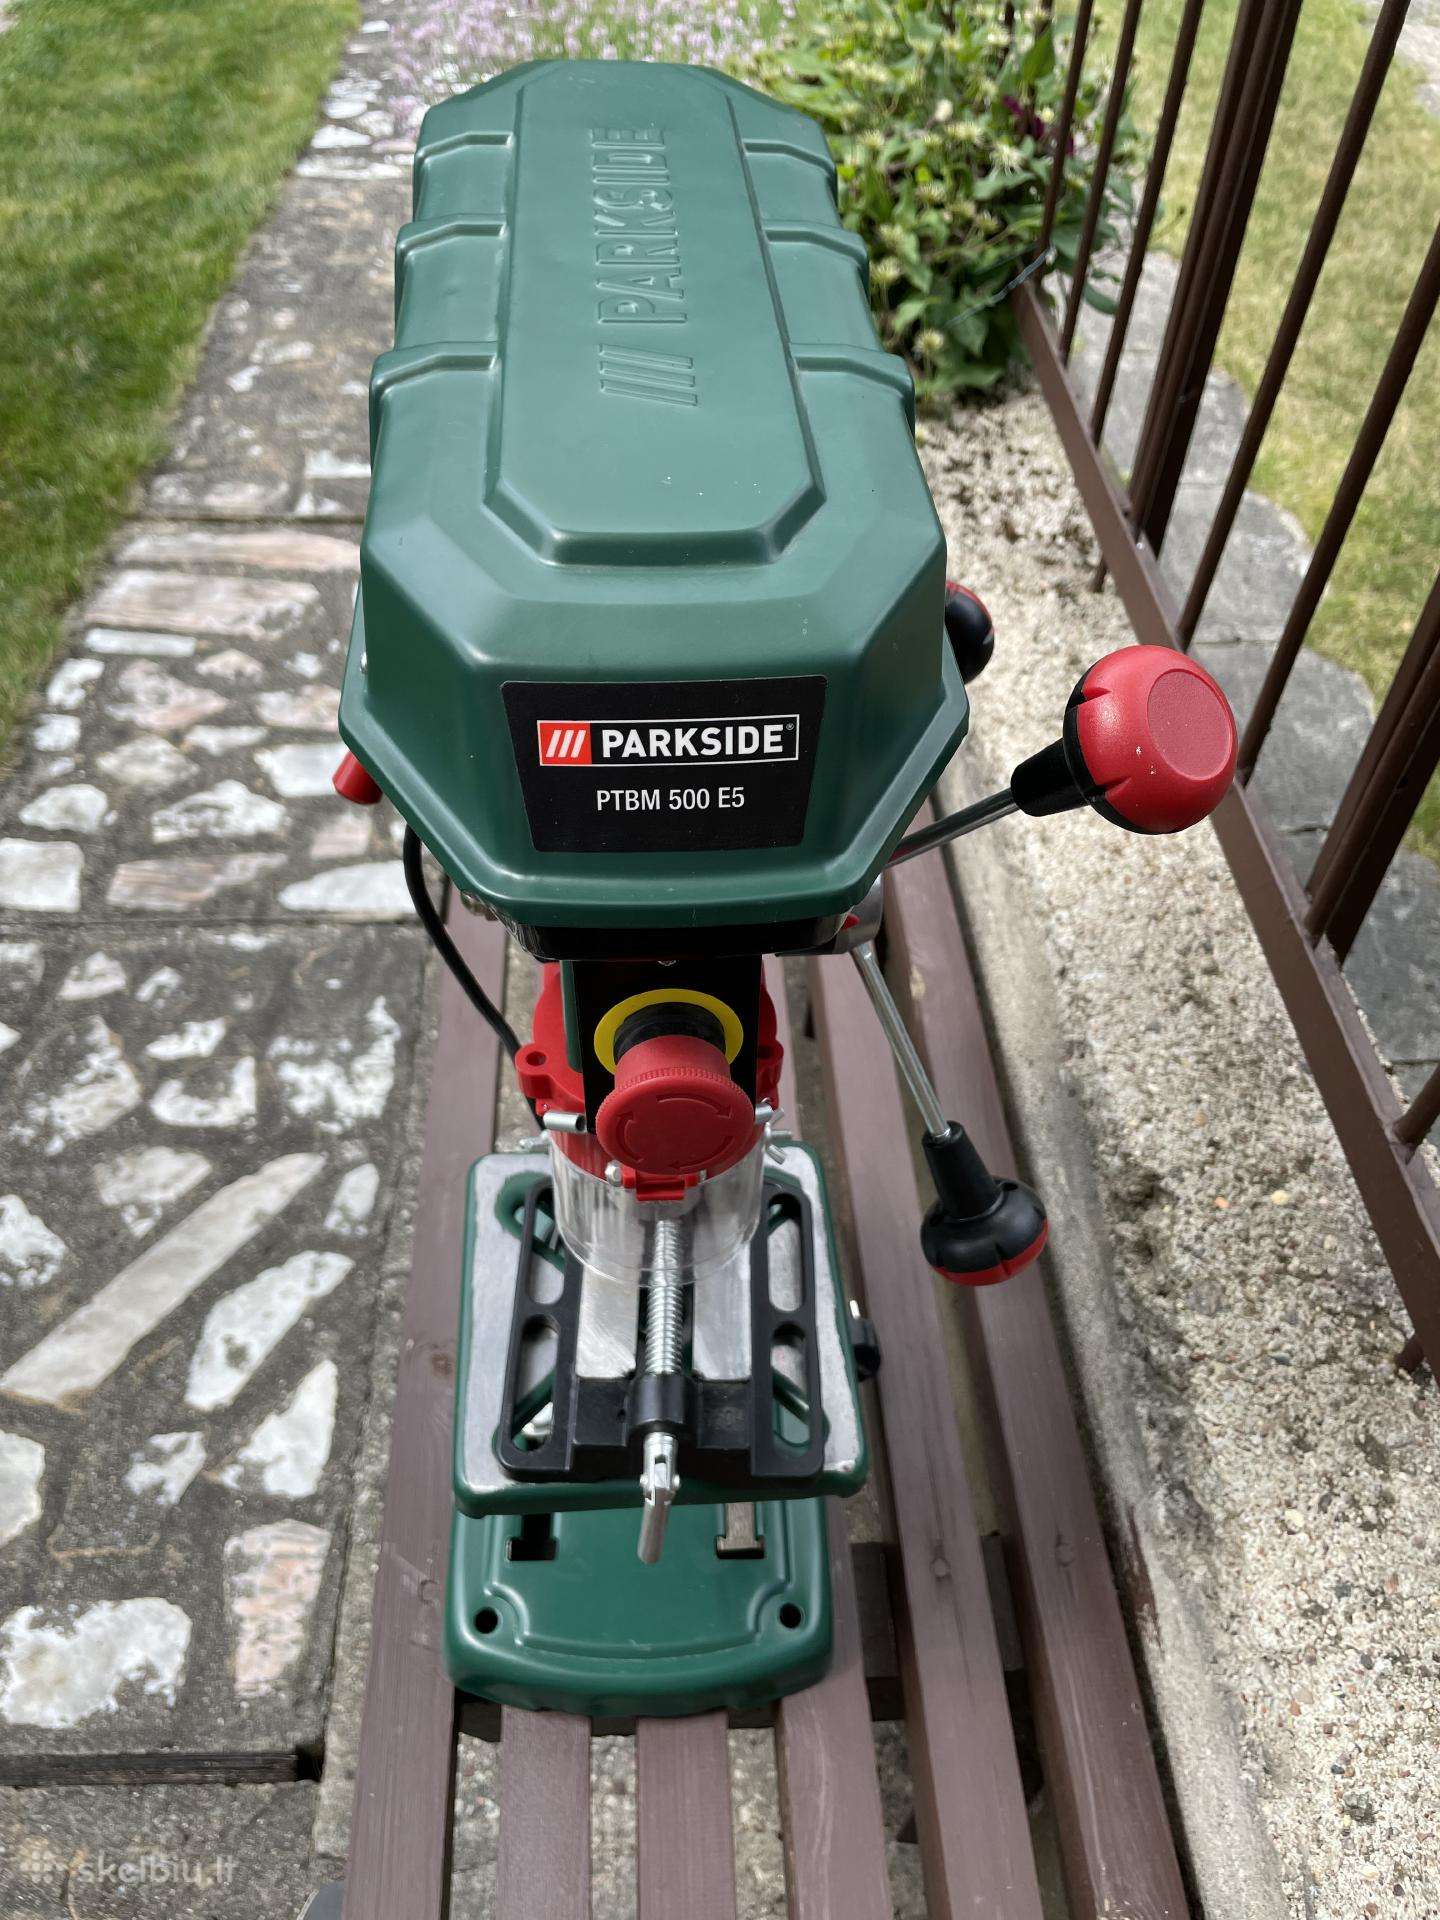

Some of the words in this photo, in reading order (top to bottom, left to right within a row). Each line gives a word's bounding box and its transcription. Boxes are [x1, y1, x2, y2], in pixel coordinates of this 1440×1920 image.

[591, 128, 687, 323] PARKSIDE
[596, 788, 661, 811] PTBM
[669, 788, 710, 810] 500
[718, 787, 745, 808] E5
